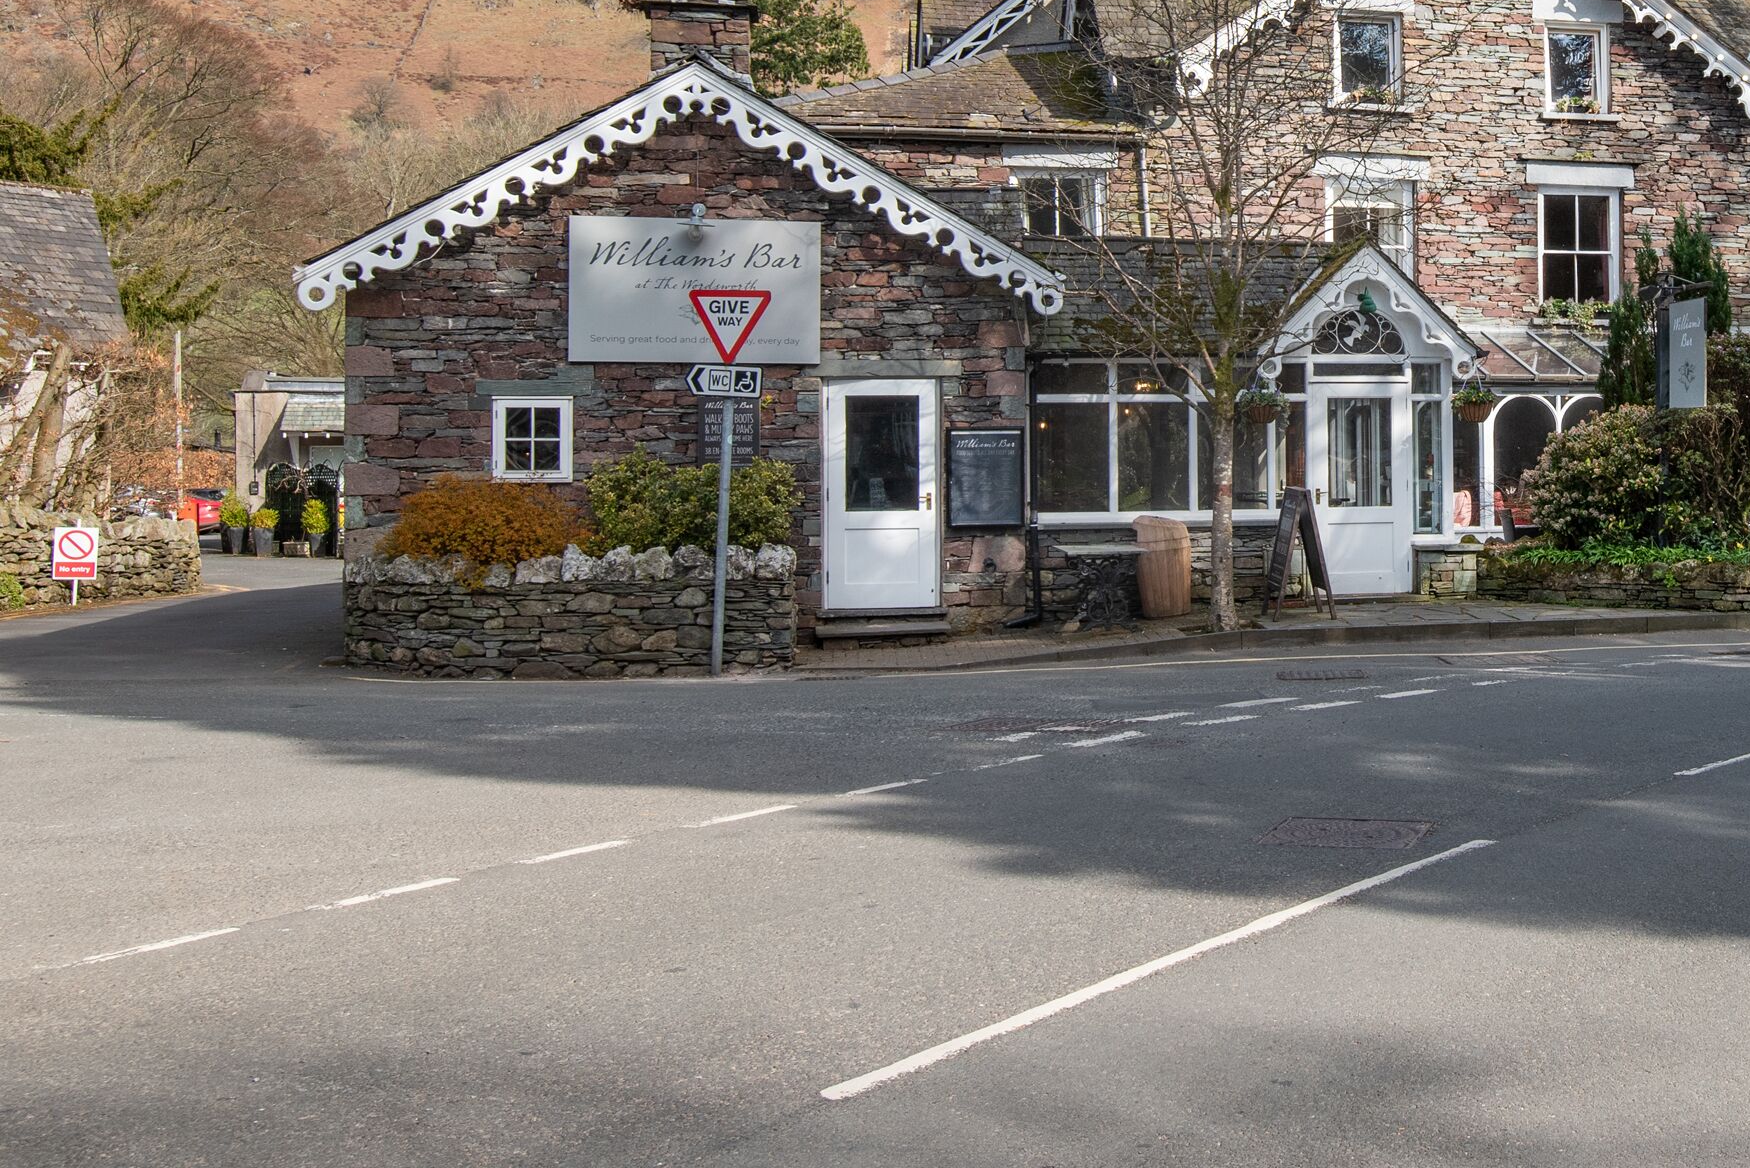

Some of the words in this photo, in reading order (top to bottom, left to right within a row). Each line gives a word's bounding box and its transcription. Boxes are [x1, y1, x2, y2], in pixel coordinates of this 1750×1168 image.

[589, 236, 736, 268] William's
[744, 242, 803, 269] Bar
[634, 278, 651, 289] at
[654, 276, 678, 290] The
[681, 279, 759, 291] Wordsworth
[708, 300, 750, 314] GIVE
[717, 316, 743, 327] WAY
[590, 334, 626, 345] Serving
[628, 335, 653, 345] great
[655, 335, 677, 344] food
[679, 335, 697, 344] and
[757, 338, 782, 346] every
[784, 337, 801, 346] day
[1680, 333, 1693, 348] Bar
[711, 374, 729, 387] WC
[734, 413, 754, 424] BOOTS
[735, 424, 754, 434] PAWS
[71, 566, 90, 574] entry
